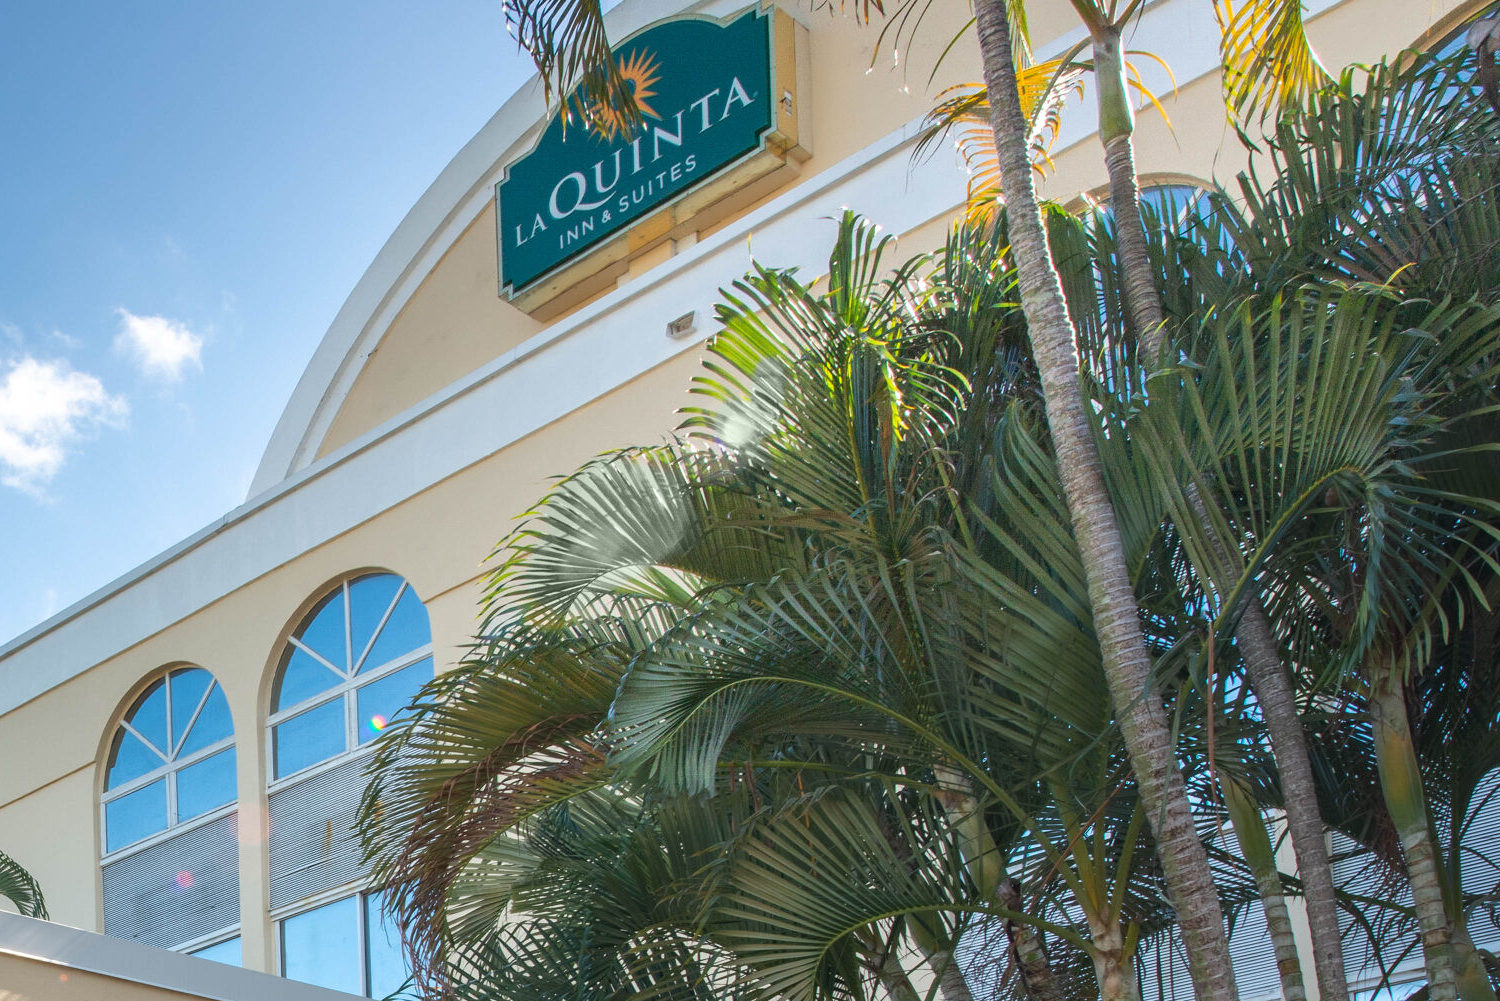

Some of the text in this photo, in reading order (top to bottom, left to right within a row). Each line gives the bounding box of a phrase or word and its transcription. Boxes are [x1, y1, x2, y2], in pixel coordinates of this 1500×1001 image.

[515, 76, 755, 247] LA QUINTA
[560, 155, 697, 249] INN & SUITES
